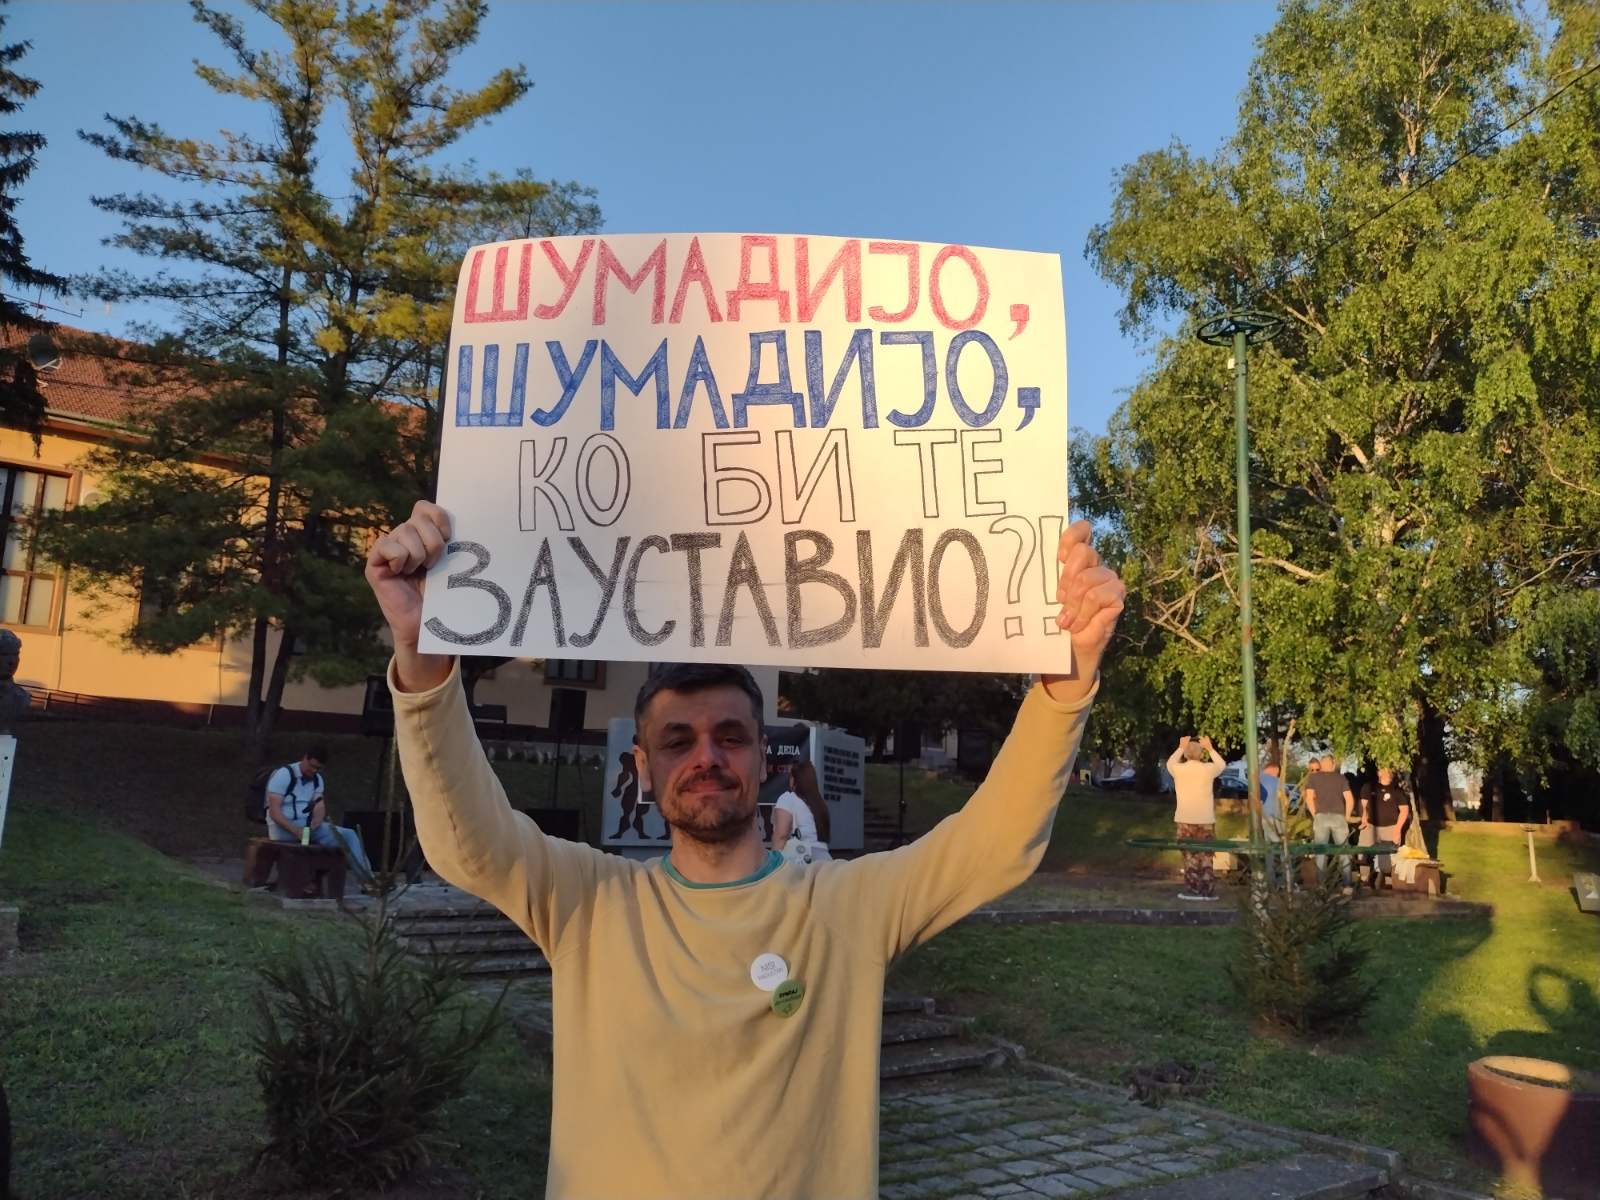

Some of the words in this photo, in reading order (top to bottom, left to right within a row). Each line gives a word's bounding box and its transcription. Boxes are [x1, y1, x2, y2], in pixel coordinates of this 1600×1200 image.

[464, 235, 1030, 340] ШУМАДИЈО,
[455, 329, 1041, 431] ШУМАДИЈО,
[518, 432, 632, 531] КО
[702, 428, 856, 526] БИ
[893, 428, 1007, 519] ТЕ
[424, 515, 1064, 649] ЗАУСТАВИО?!
